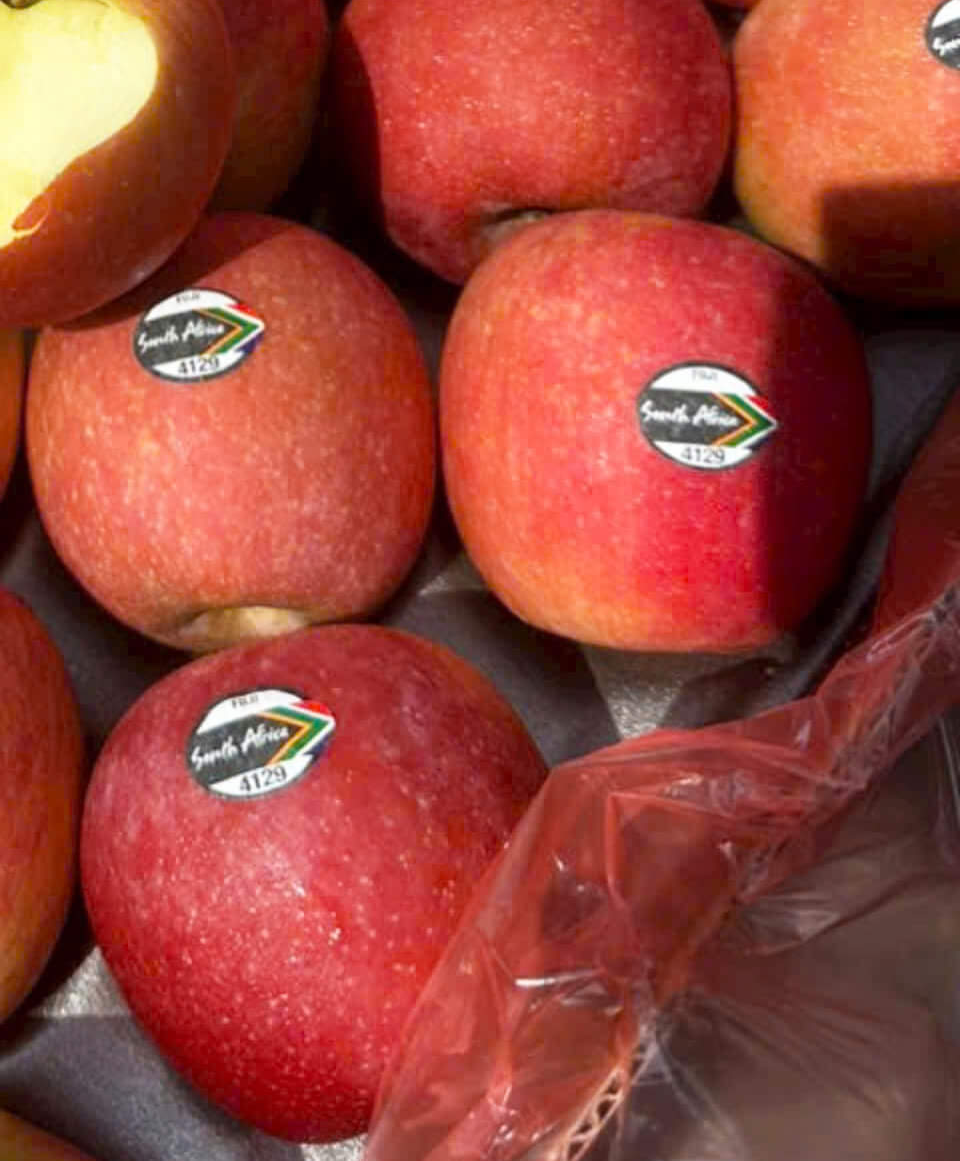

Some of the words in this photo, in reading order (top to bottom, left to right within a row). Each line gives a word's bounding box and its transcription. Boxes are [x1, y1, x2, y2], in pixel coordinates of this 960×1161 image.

[177, 357, 221, 375] 4129
[680, 446, 726, 464] 4129
[239, 766, 287, 792] 4129
